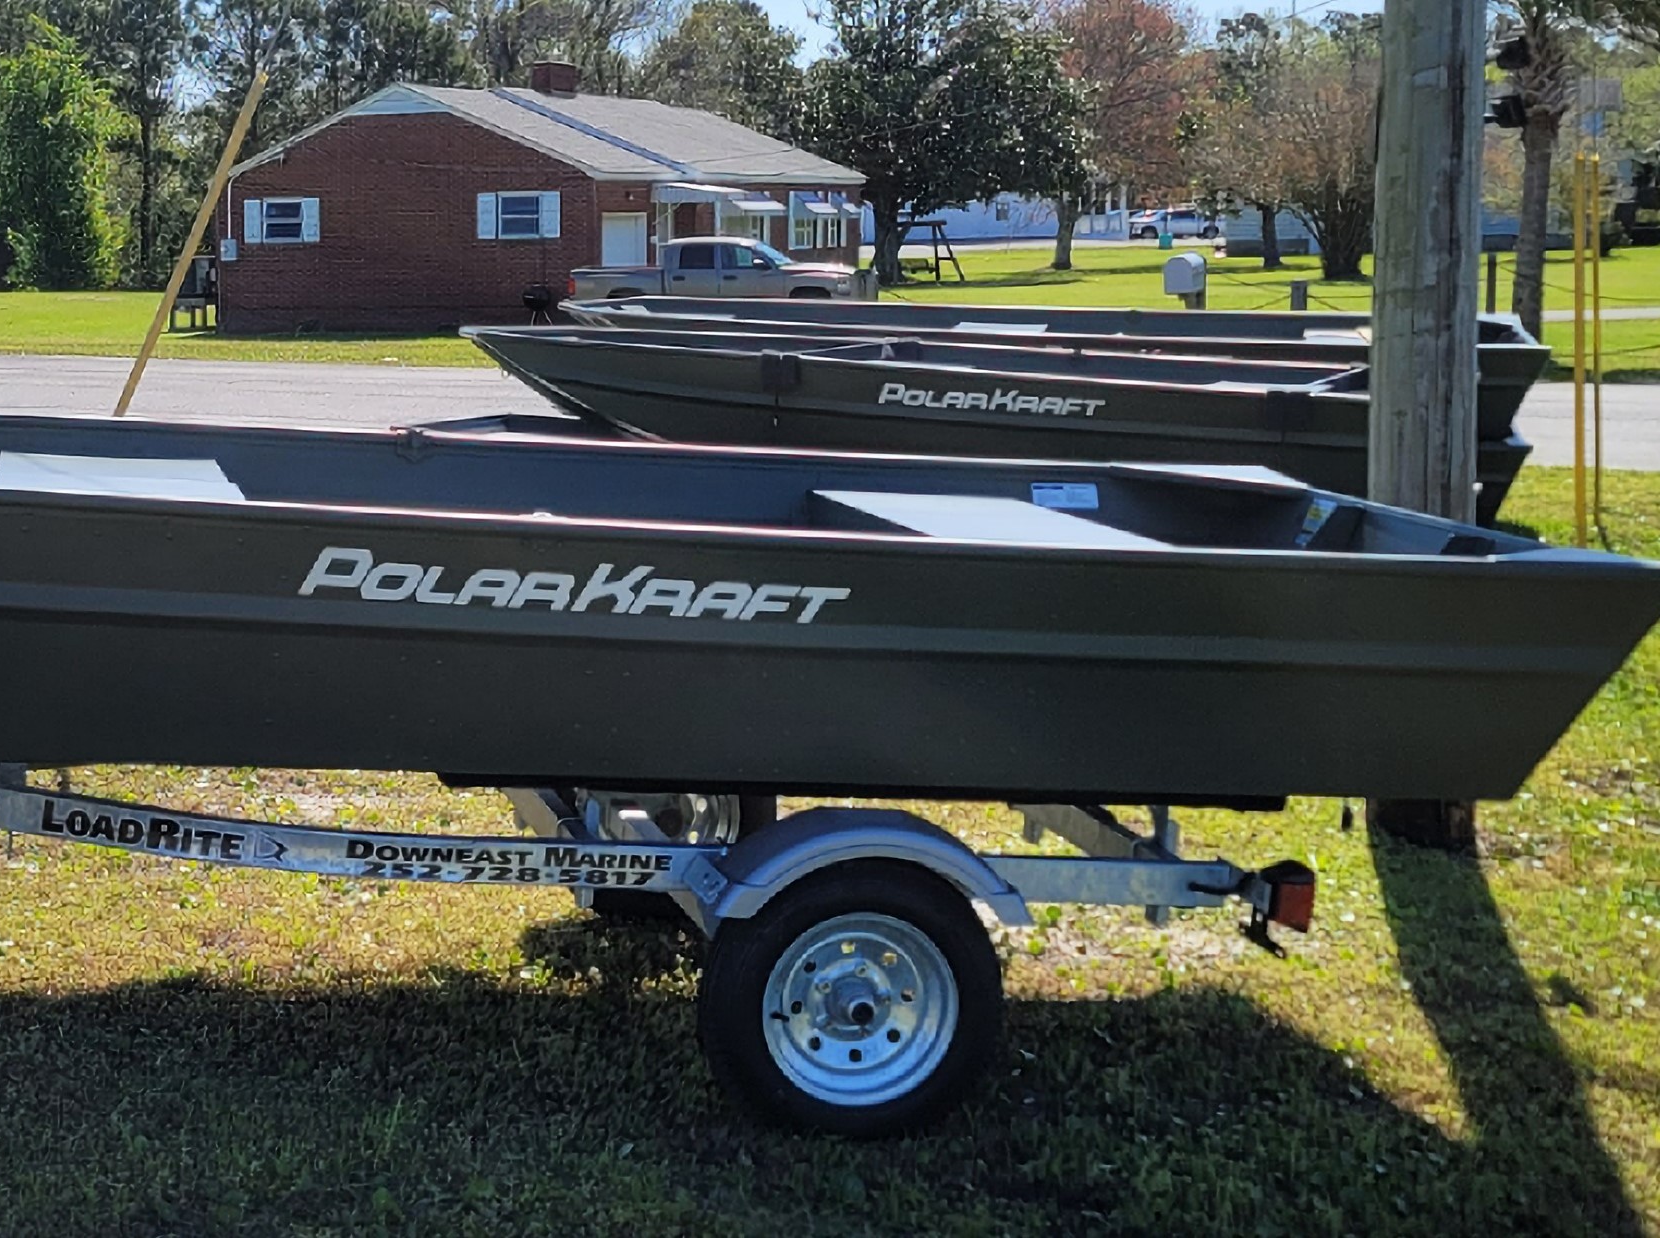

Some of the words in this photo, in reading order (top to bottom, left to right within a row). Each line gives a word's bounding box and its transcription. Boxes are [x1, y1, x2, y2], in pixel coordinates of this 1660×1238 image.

[877, 382, 1106, 416] POLARKRAFT
[298, 546, 851, 623] POLARKRAFT
[345, 839, 534, 866] DOWNEAST
[543, 846, 674, 872] MARINE
[360, 860, 657, 886] 252-728-5817
